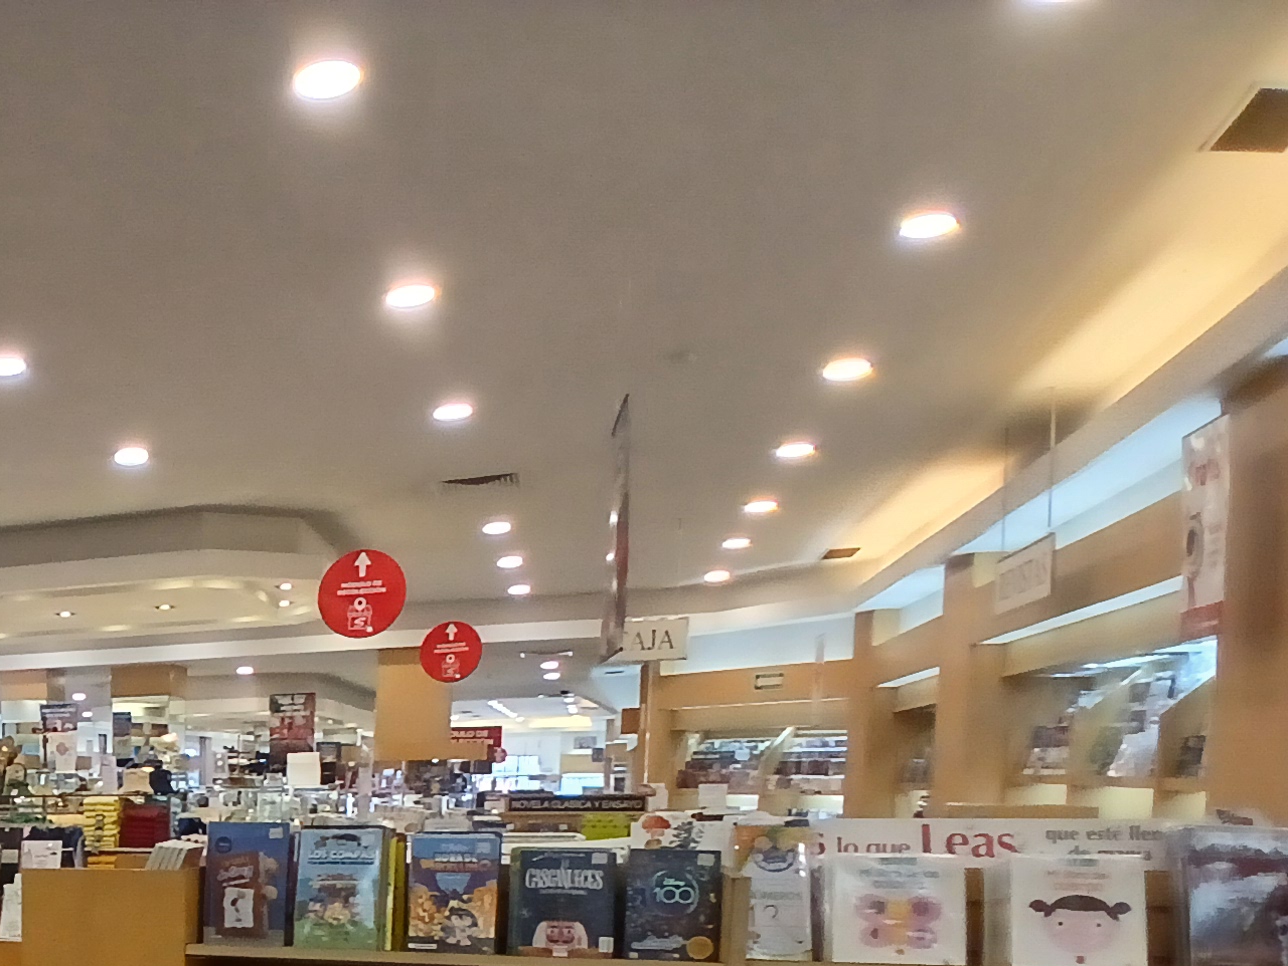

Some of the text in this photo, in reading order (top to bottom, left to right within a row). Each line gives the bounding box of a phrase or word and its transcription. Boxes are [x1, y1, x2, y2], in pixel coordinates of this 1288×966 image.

[623, 628, 674, 650] AJA
[921, 823, 1019, 858] Leas
[653, 887, 695, 904] 100
